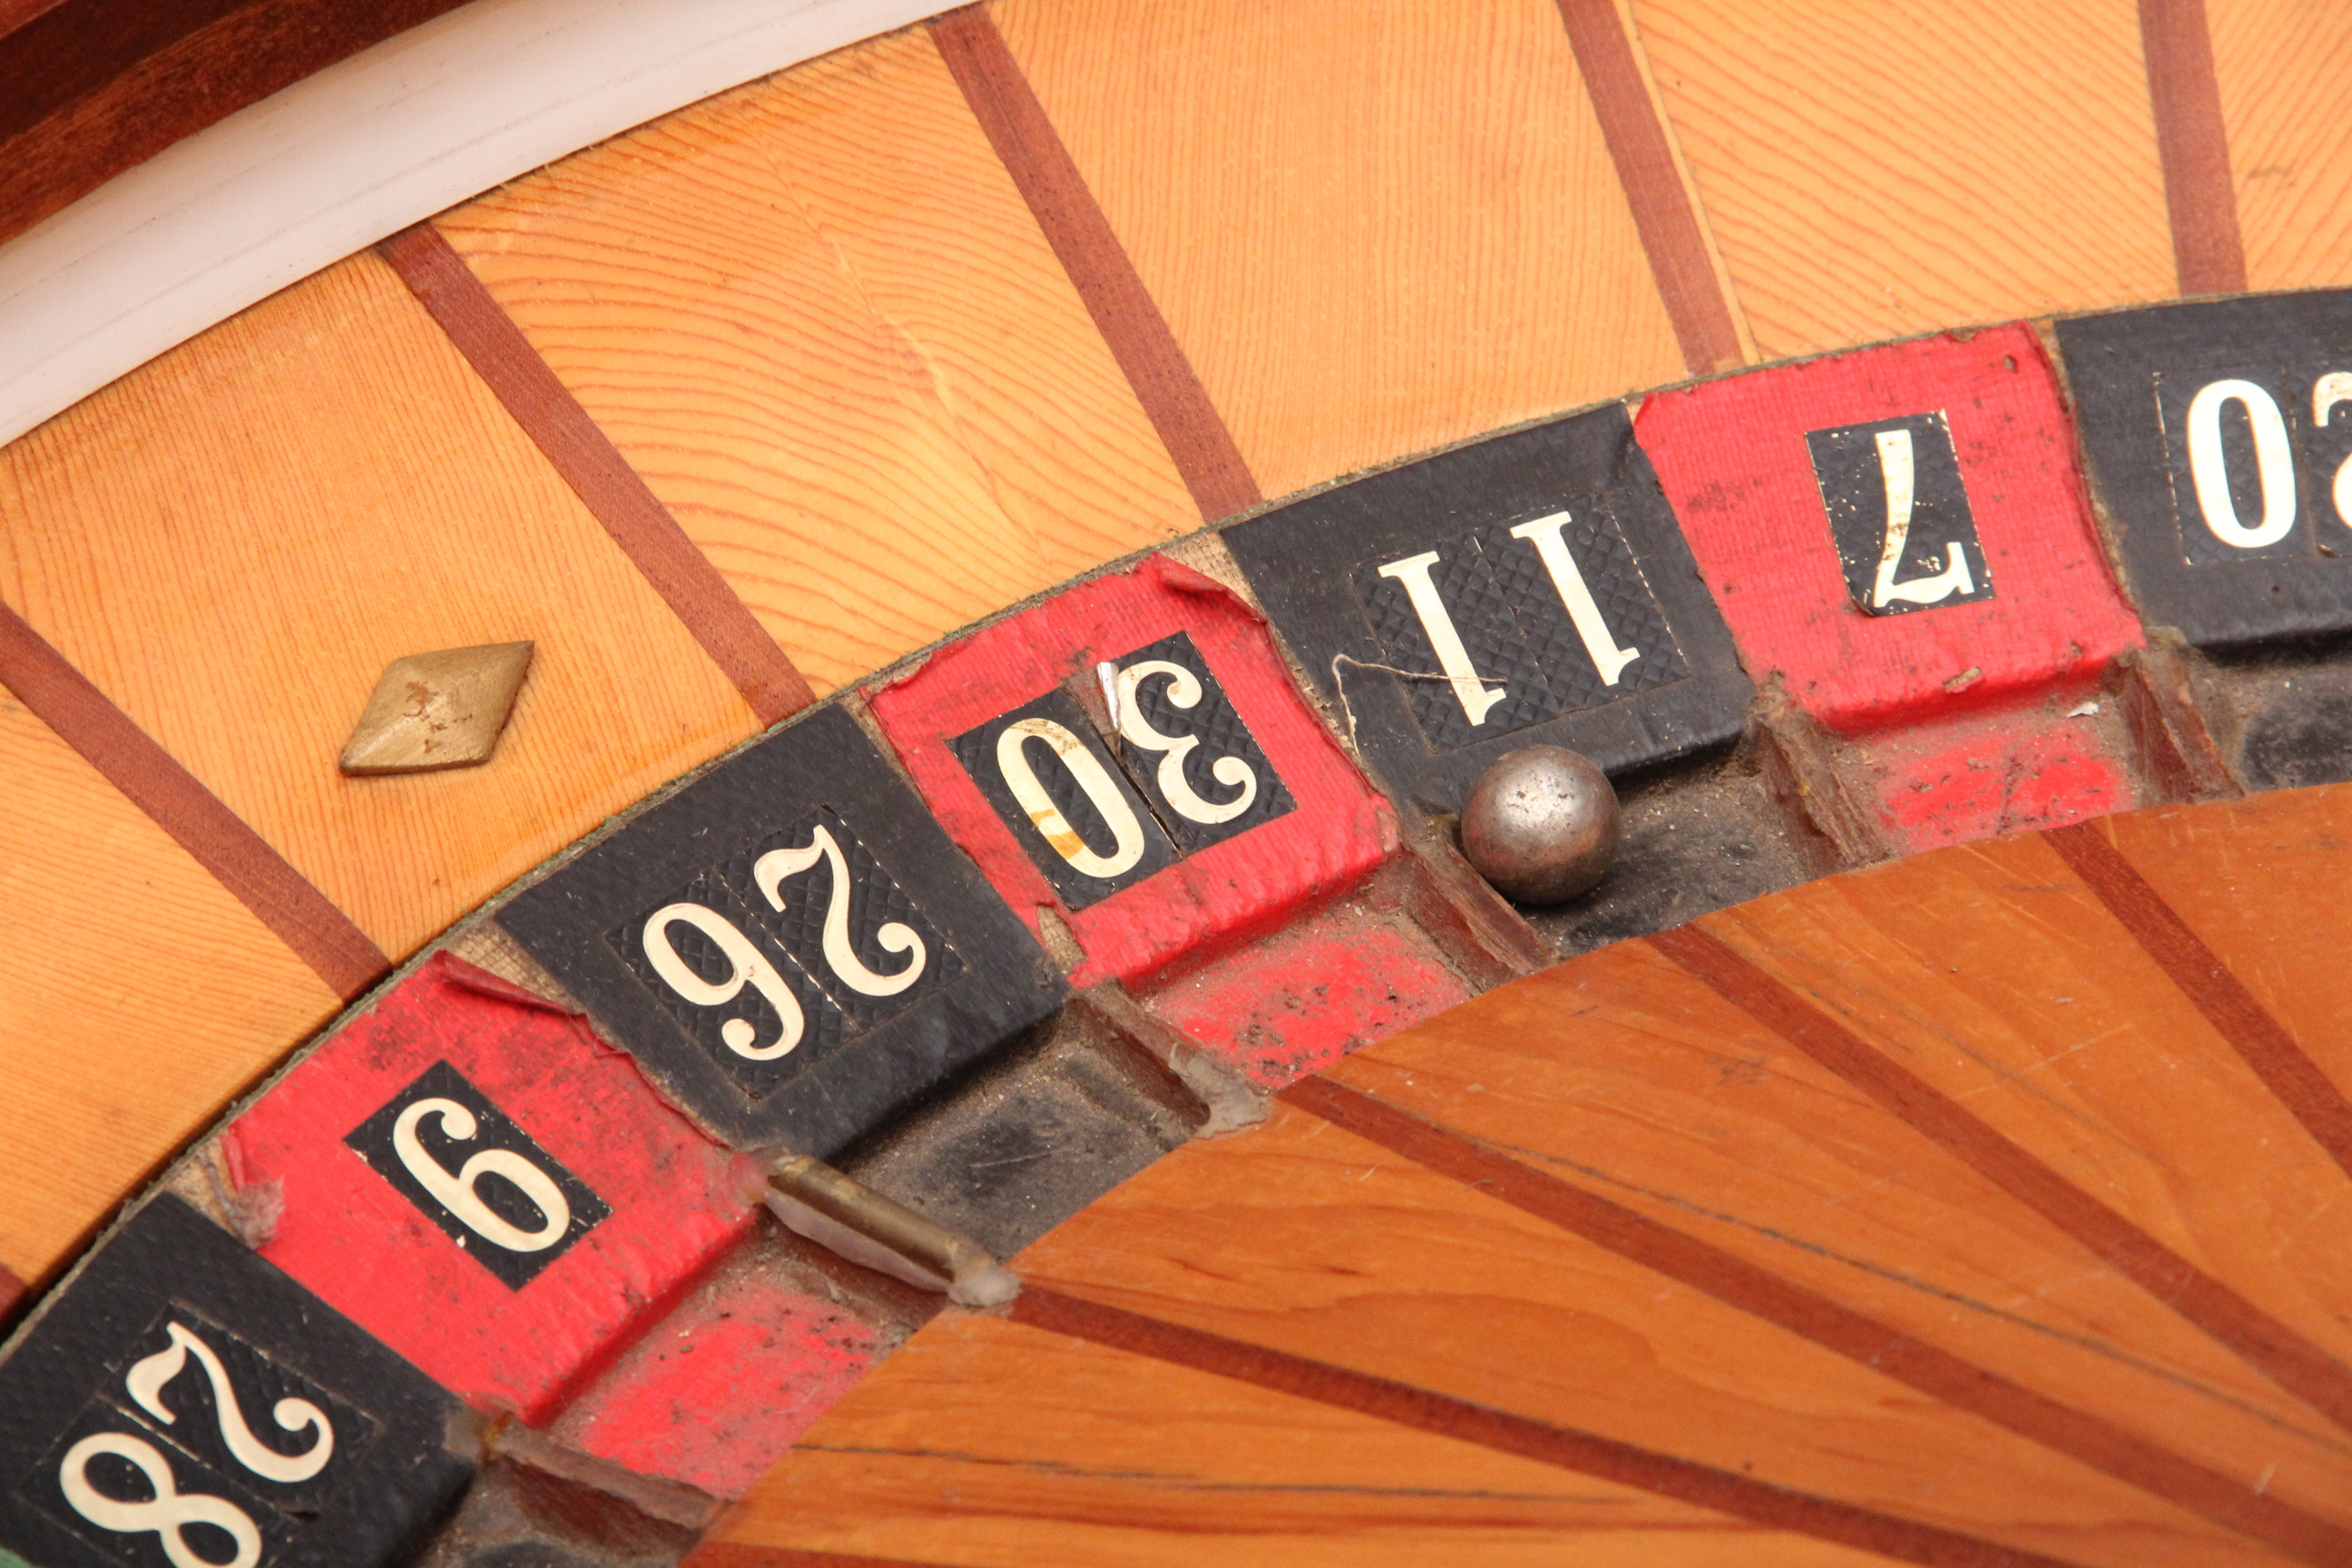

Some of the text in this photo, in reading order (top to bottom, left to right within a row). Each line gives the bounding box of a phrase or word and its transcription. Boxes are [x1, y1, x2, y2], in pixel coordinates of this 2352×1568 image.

[1377, 511, 1641, 727] 11
[1874, 428, 1975, 608] 7
[995, 659, 1258, 878] 30
[642, 823, 926, 1061] 26
[392, 1097, 571, 1252] 9
[59, 1319, 335, 1568] 28
